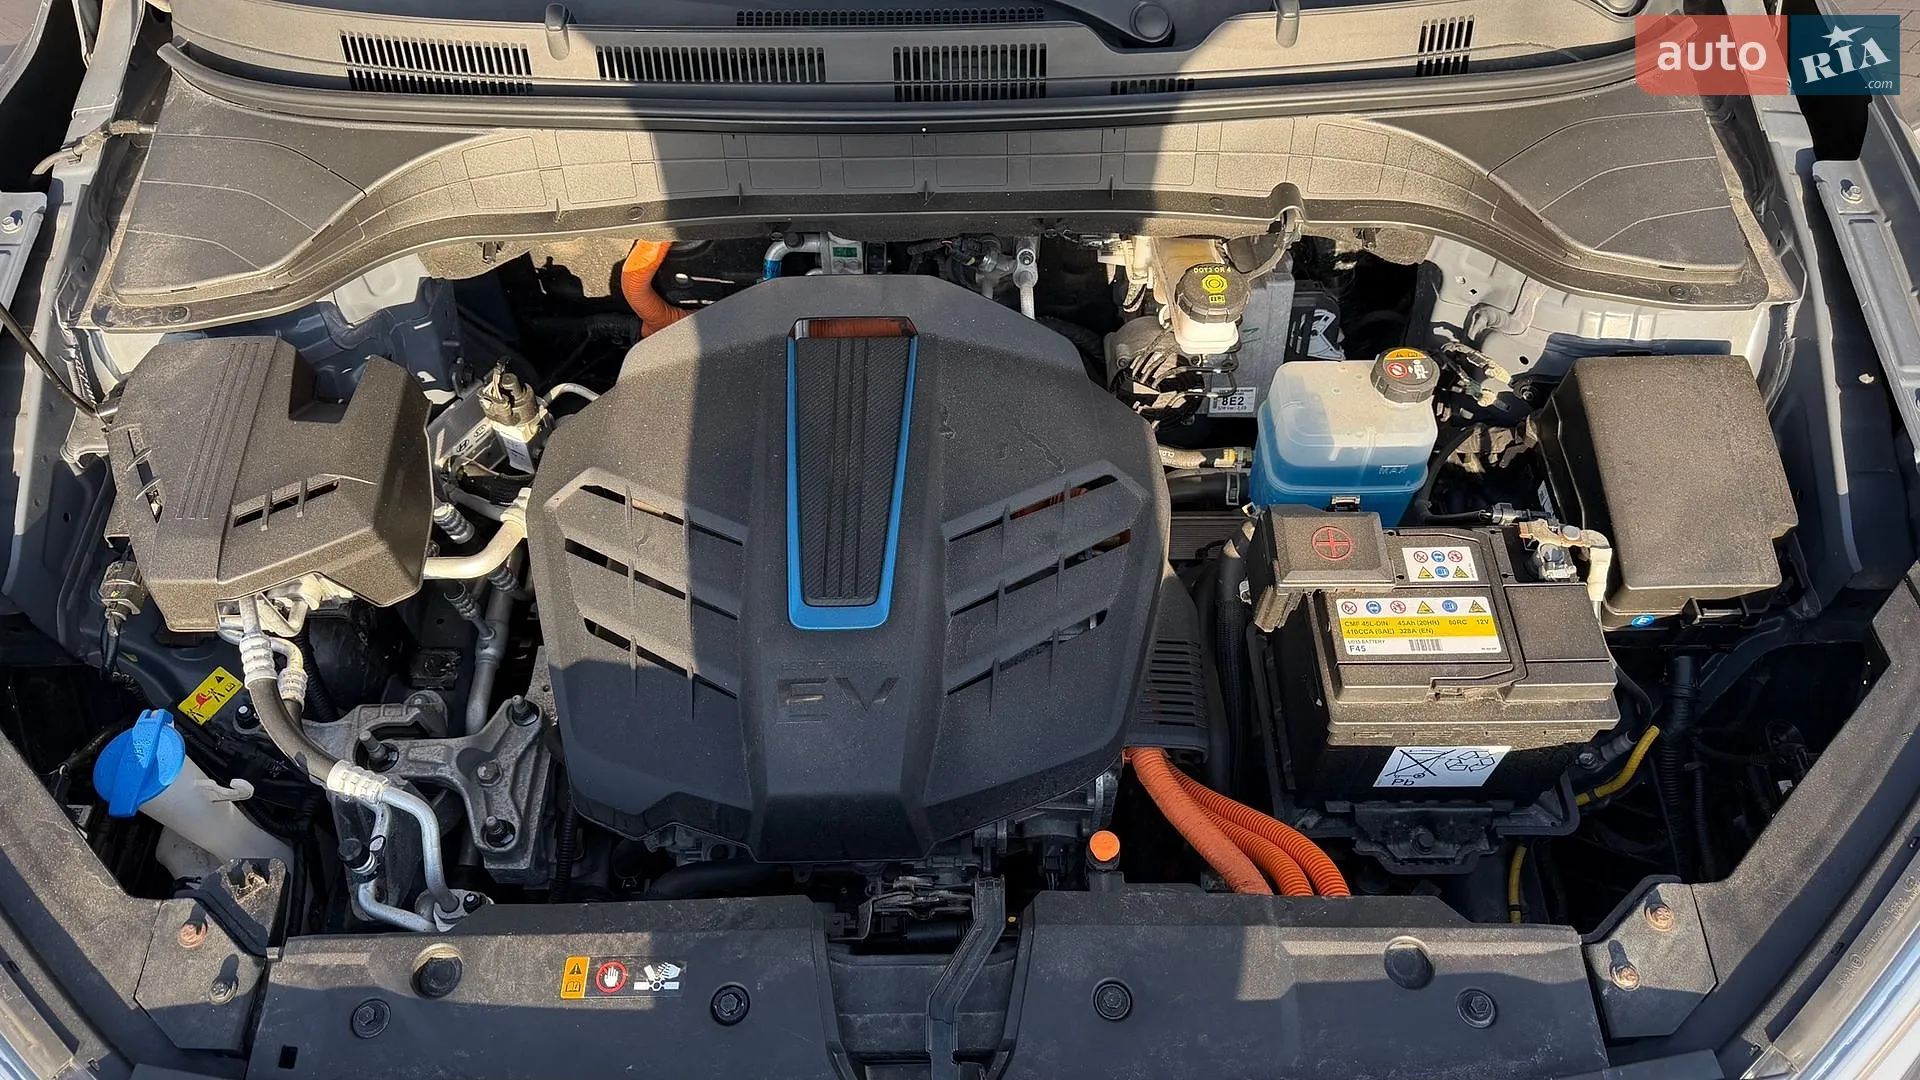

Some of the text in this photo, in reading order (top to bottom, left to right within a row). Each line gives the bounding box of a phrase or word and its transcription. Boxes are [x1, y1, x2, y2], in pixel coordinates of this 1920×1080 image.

[1221, 396, 1245, 406] 8E2
[1349, 645, 1367, 653] F45
[776, 677, 901, 723] EV
[1391, 778, 1415, 786] Pb
